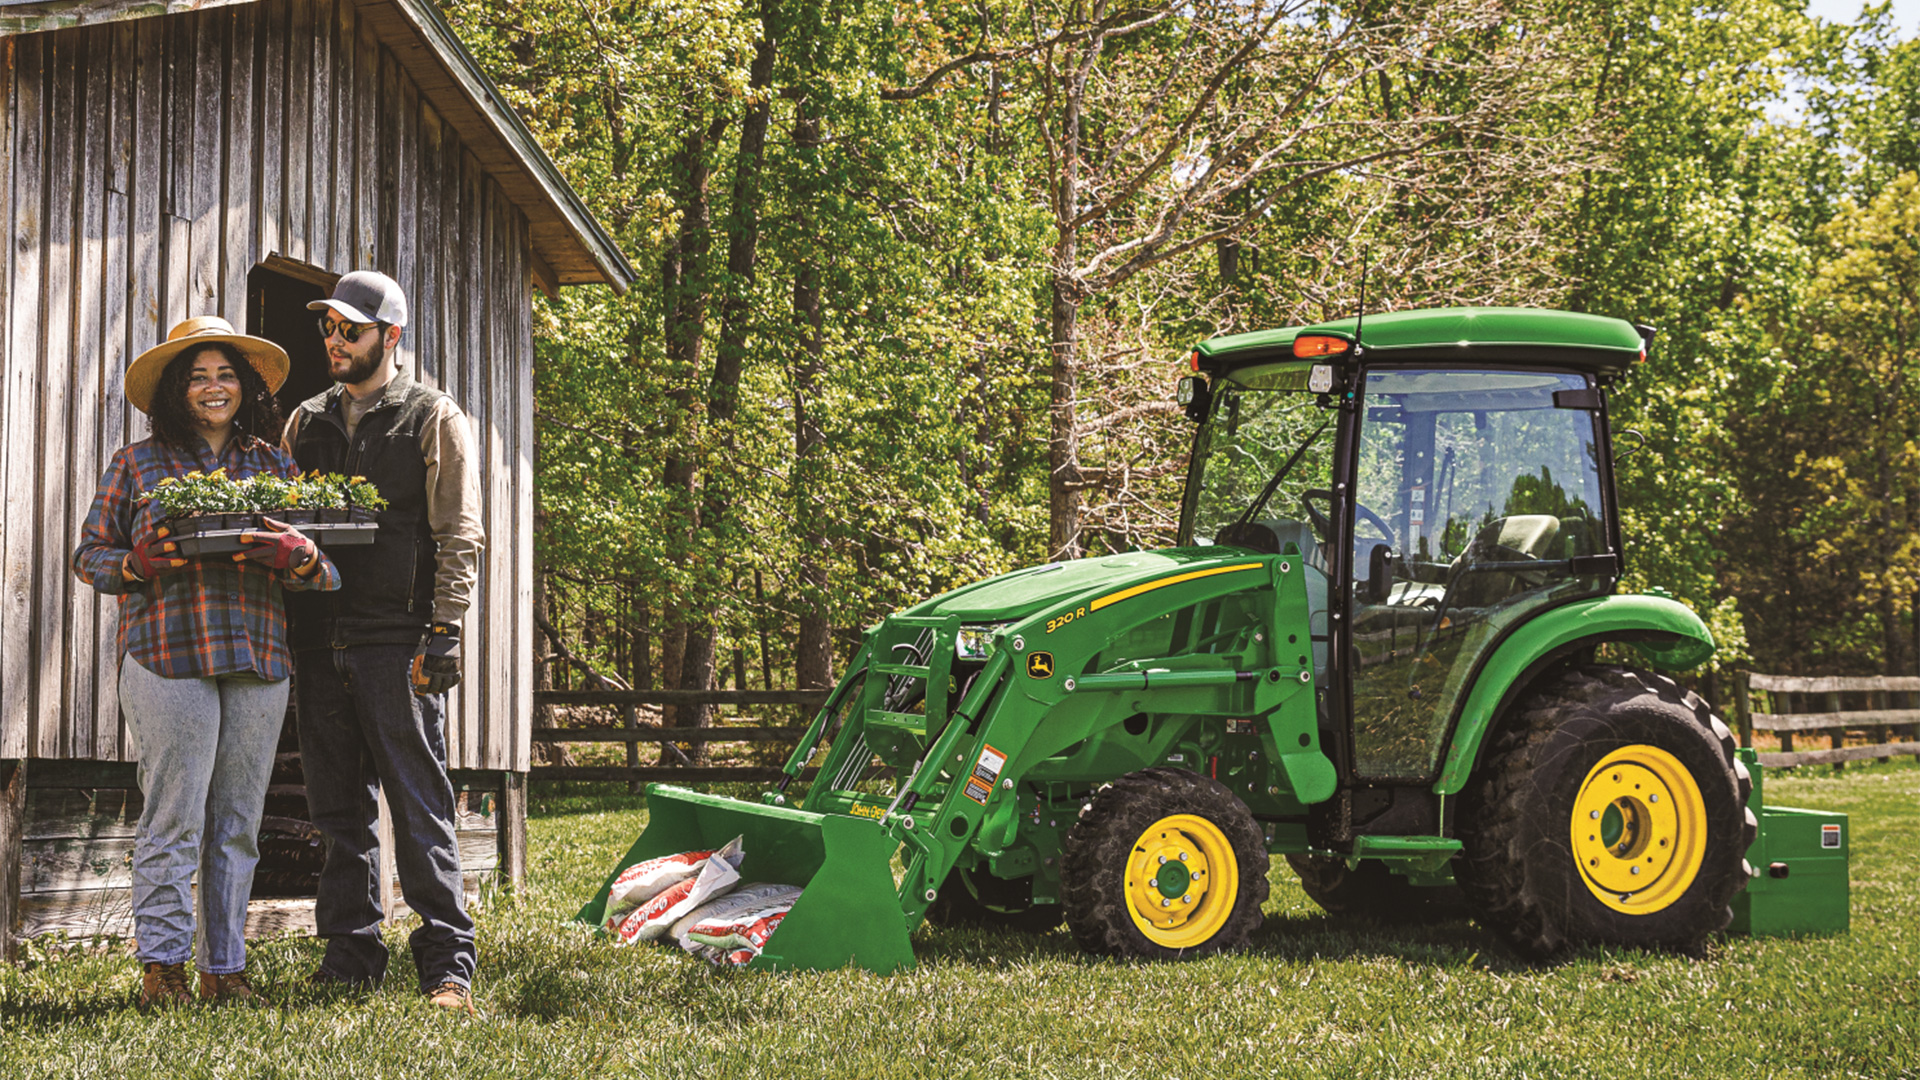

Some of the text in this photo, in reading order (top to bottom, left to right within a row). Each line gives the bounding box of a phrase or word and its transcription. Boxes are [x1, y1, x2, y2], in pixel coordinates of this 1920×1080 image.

[1046, 606, 1086, 634] 320 R
[871, 805, 886, 819] DEE
